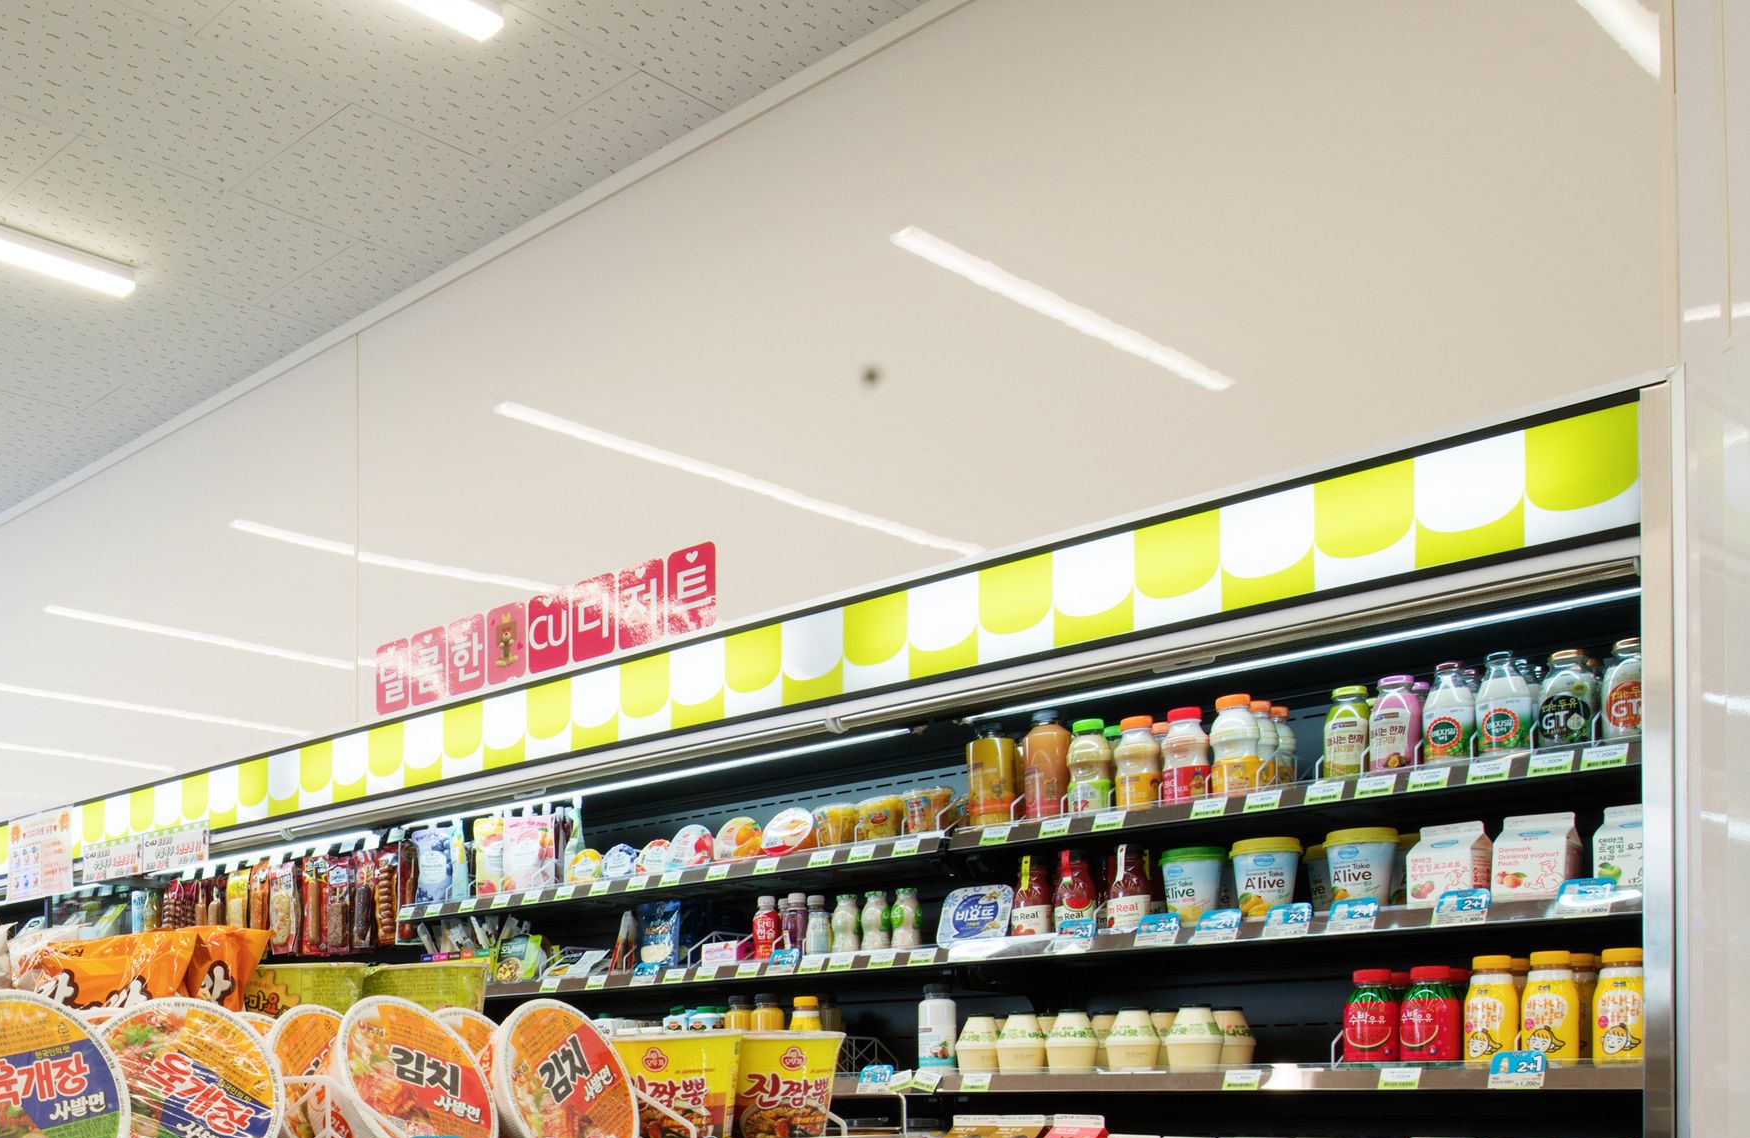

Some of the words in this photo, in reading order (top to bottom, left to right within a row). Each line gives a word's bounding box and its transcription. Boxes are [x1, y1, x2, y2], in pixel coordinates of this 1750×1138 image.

[1498, 853, 1526, 862] Drinking
[1528, 851, 1559, 861] yoghurt
[1116, 902, 1138, 913] Real
[1352, 904, 1375, 918] 2+1
[1462, 893, 1486, 911] 2+1
[1156, 921, 1179, 932] 2+1
[1217, 917, 1237, 928] 2+1
[1288, 912, 1310, 924] 2+1
[390, 1044, 462, 1098] 김치
[537, 1034, 591, 1105] 김치
[1517, 1055, 1542, 1073] 2+1
[584, 1065, 614, 1102] 사발면
[745, 1072, 829, 1108] 진짬뽕
[145, 1052, 255, 1136] 육개장
[49, 1091, 107, 1122] 사발면
[434, 1094, 482, 1124] 사발면
